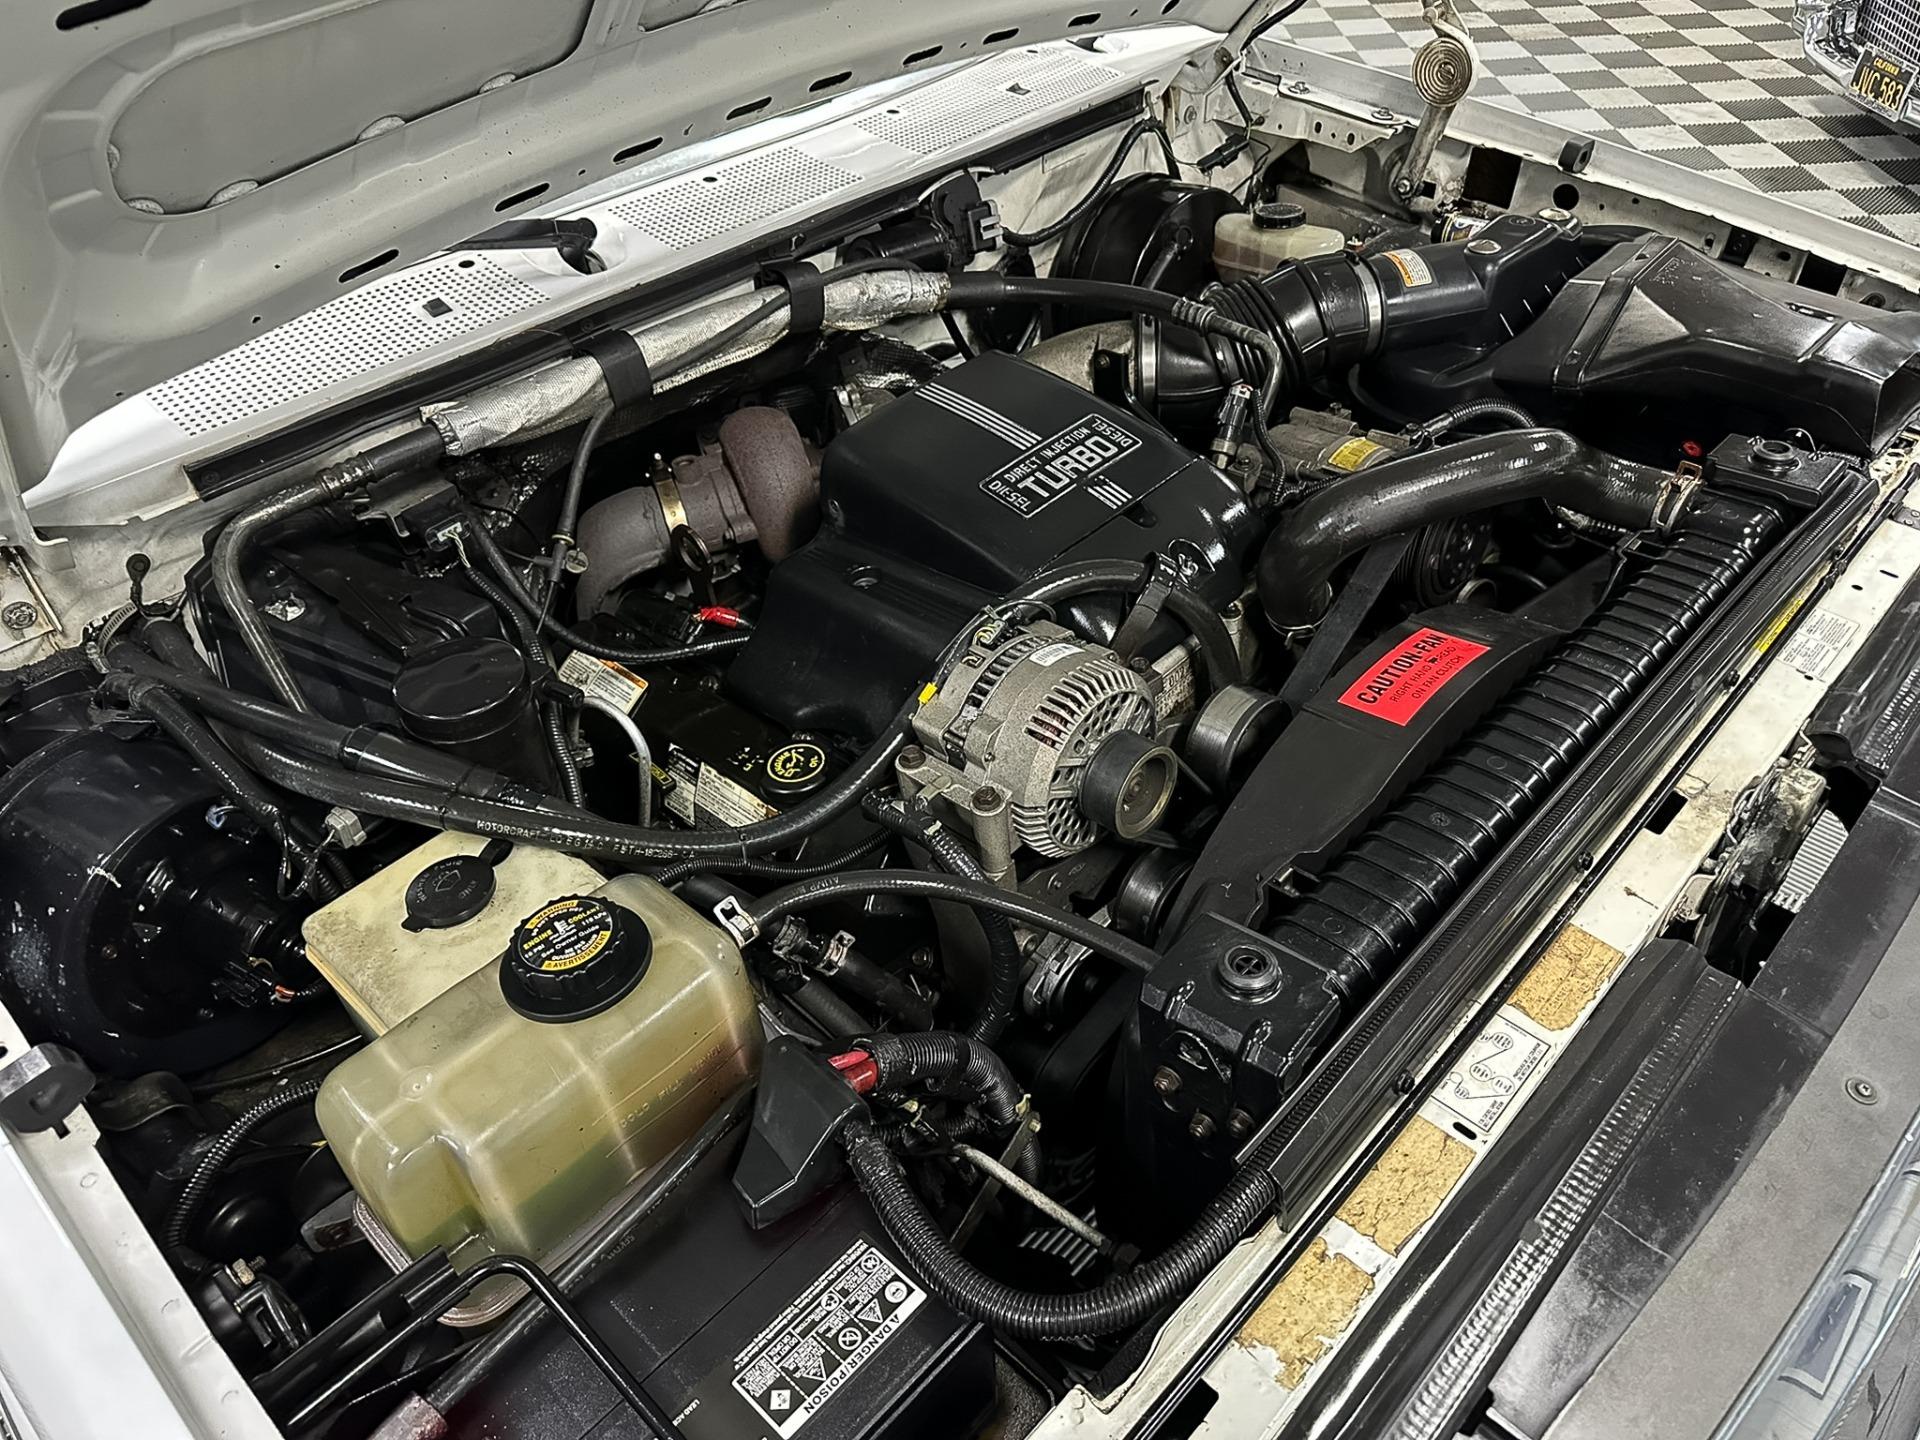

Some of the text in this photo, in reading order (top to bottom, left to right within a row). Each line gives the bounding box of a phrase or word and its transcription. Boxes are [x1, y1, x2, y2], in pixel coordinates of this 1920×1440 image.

[1879, 76, 1904, 111] 583
[1091, 417, 1133, 448] DIESEL
[1003, 426, 1091, 483] DIRECT INJECTION
[1017, 435, 1118, 498] TURBO
[988, 479, 1032, 512] DIESEL
[1357, 633, 1449, 704] CAUTION-FAN
[1389, 680, 1414, 703] RIGHT
[1410, 664, 1432, 683] HAND
[1411, 654, 1464, 699] ON FAN CLUTCH
[476, 820, 541, 840] MOTORCRAFT
[522, 905, 601, 950] ENGINE COOLANT
[555, 935, 578, 950] Owner
[578, 925, 600, 937] Guide
[552, 932, 608, 969] AVERTISSEMENT
[802, 1323, 893, 1414] DANGER/POISON
[683, 1399, 700, 1415] LEAD
